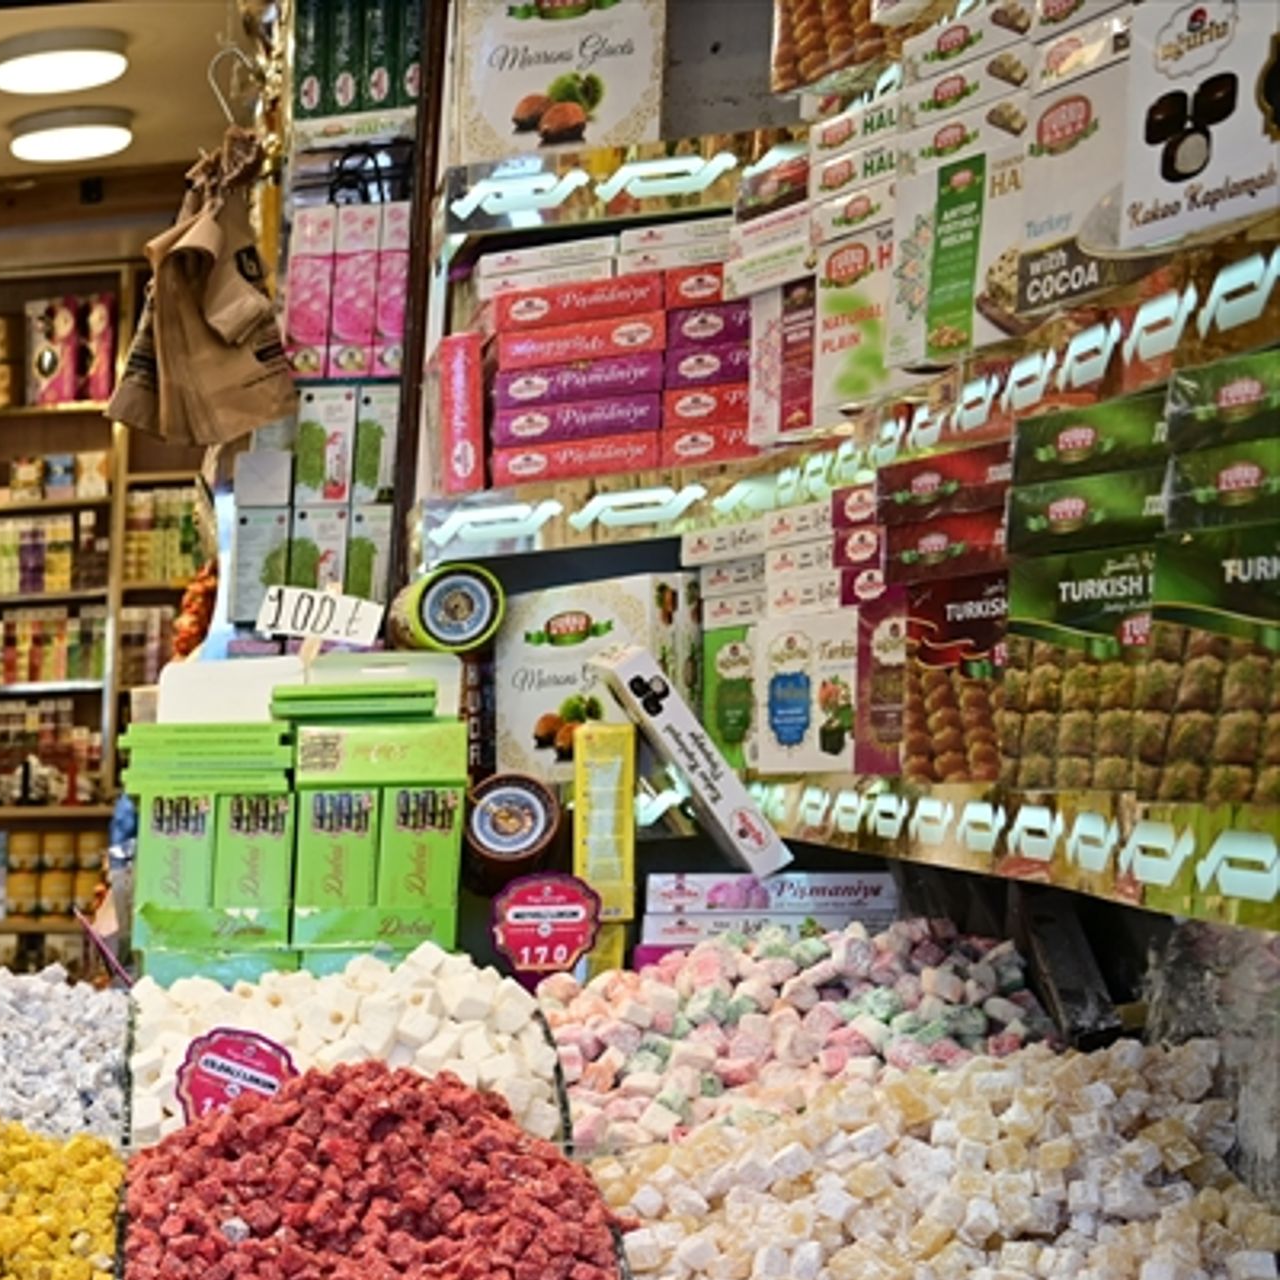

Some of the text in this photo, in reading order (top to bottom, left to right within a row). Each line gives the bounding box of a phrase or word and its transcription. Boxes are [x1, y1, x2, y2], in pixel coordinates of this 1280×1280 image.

[1030, 248, 1068, 276] with
[1026, 261, 1100, 303] COCOA
[1059, 575, 1145, 603] TURKISH
[520, 943, 568, 966] 170
